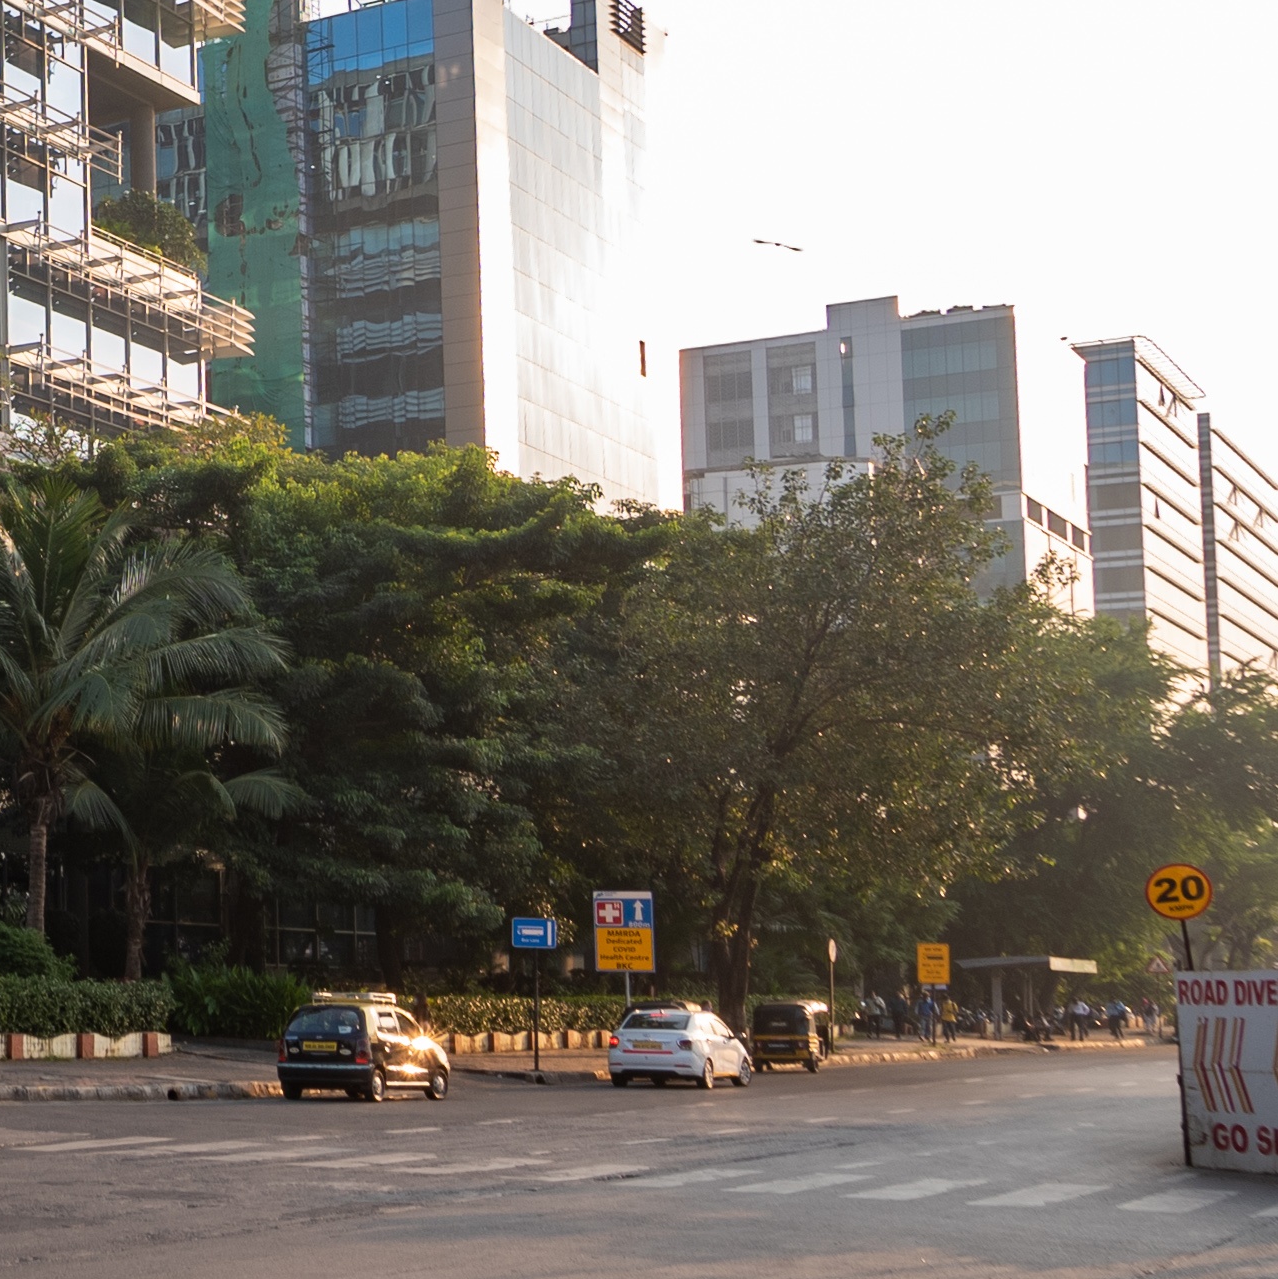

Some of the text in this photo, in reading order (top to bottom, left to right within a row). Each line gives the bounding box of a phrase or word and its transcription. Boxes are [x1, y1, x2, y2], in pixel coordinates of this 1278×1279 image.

[1154, 875, 1205, 904] 20
[606, 929, 641, 937] MMRDA
[1177, 978, 1278, 1007] ROAD DIVE
[1212, 1122, 1249, 1154] GO
